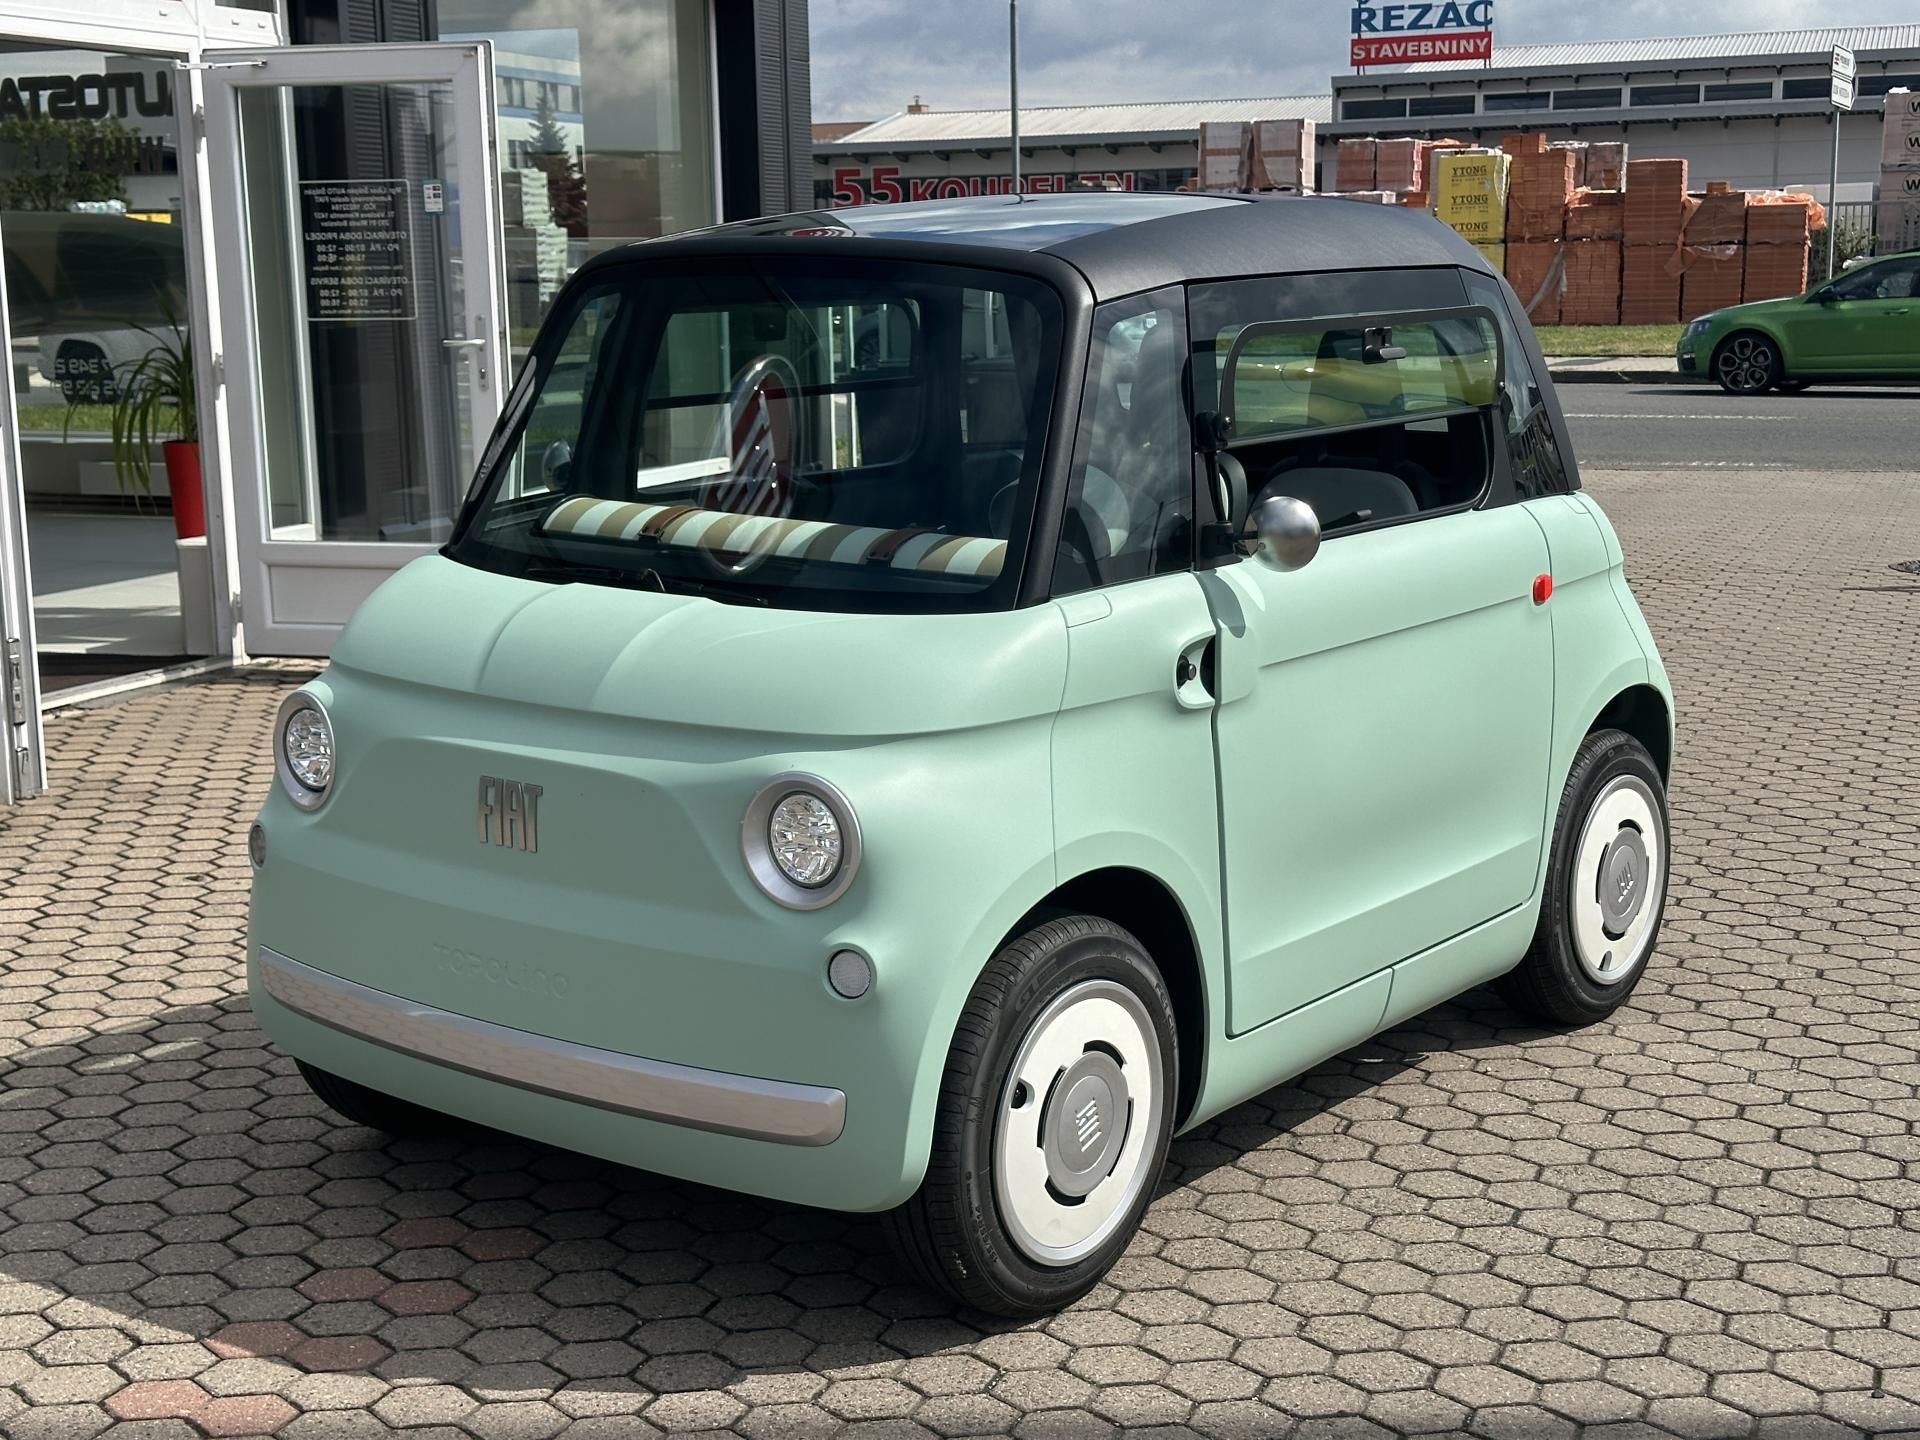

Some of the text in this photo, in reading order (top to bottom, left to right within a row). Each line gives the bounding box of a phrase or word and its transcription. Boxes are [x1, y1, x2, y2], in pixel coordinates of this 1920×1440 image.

[1353, 38, 1489, 60] STAVEBNINY
[1452, 165, 1487, 176] YTONG
[832, 165, 903, 208] 55
[1451, 194, 1488, 205] YTONG
[1451, 222, 1488, 232] YTONG
[479, 775, 544, 854] FIAT
